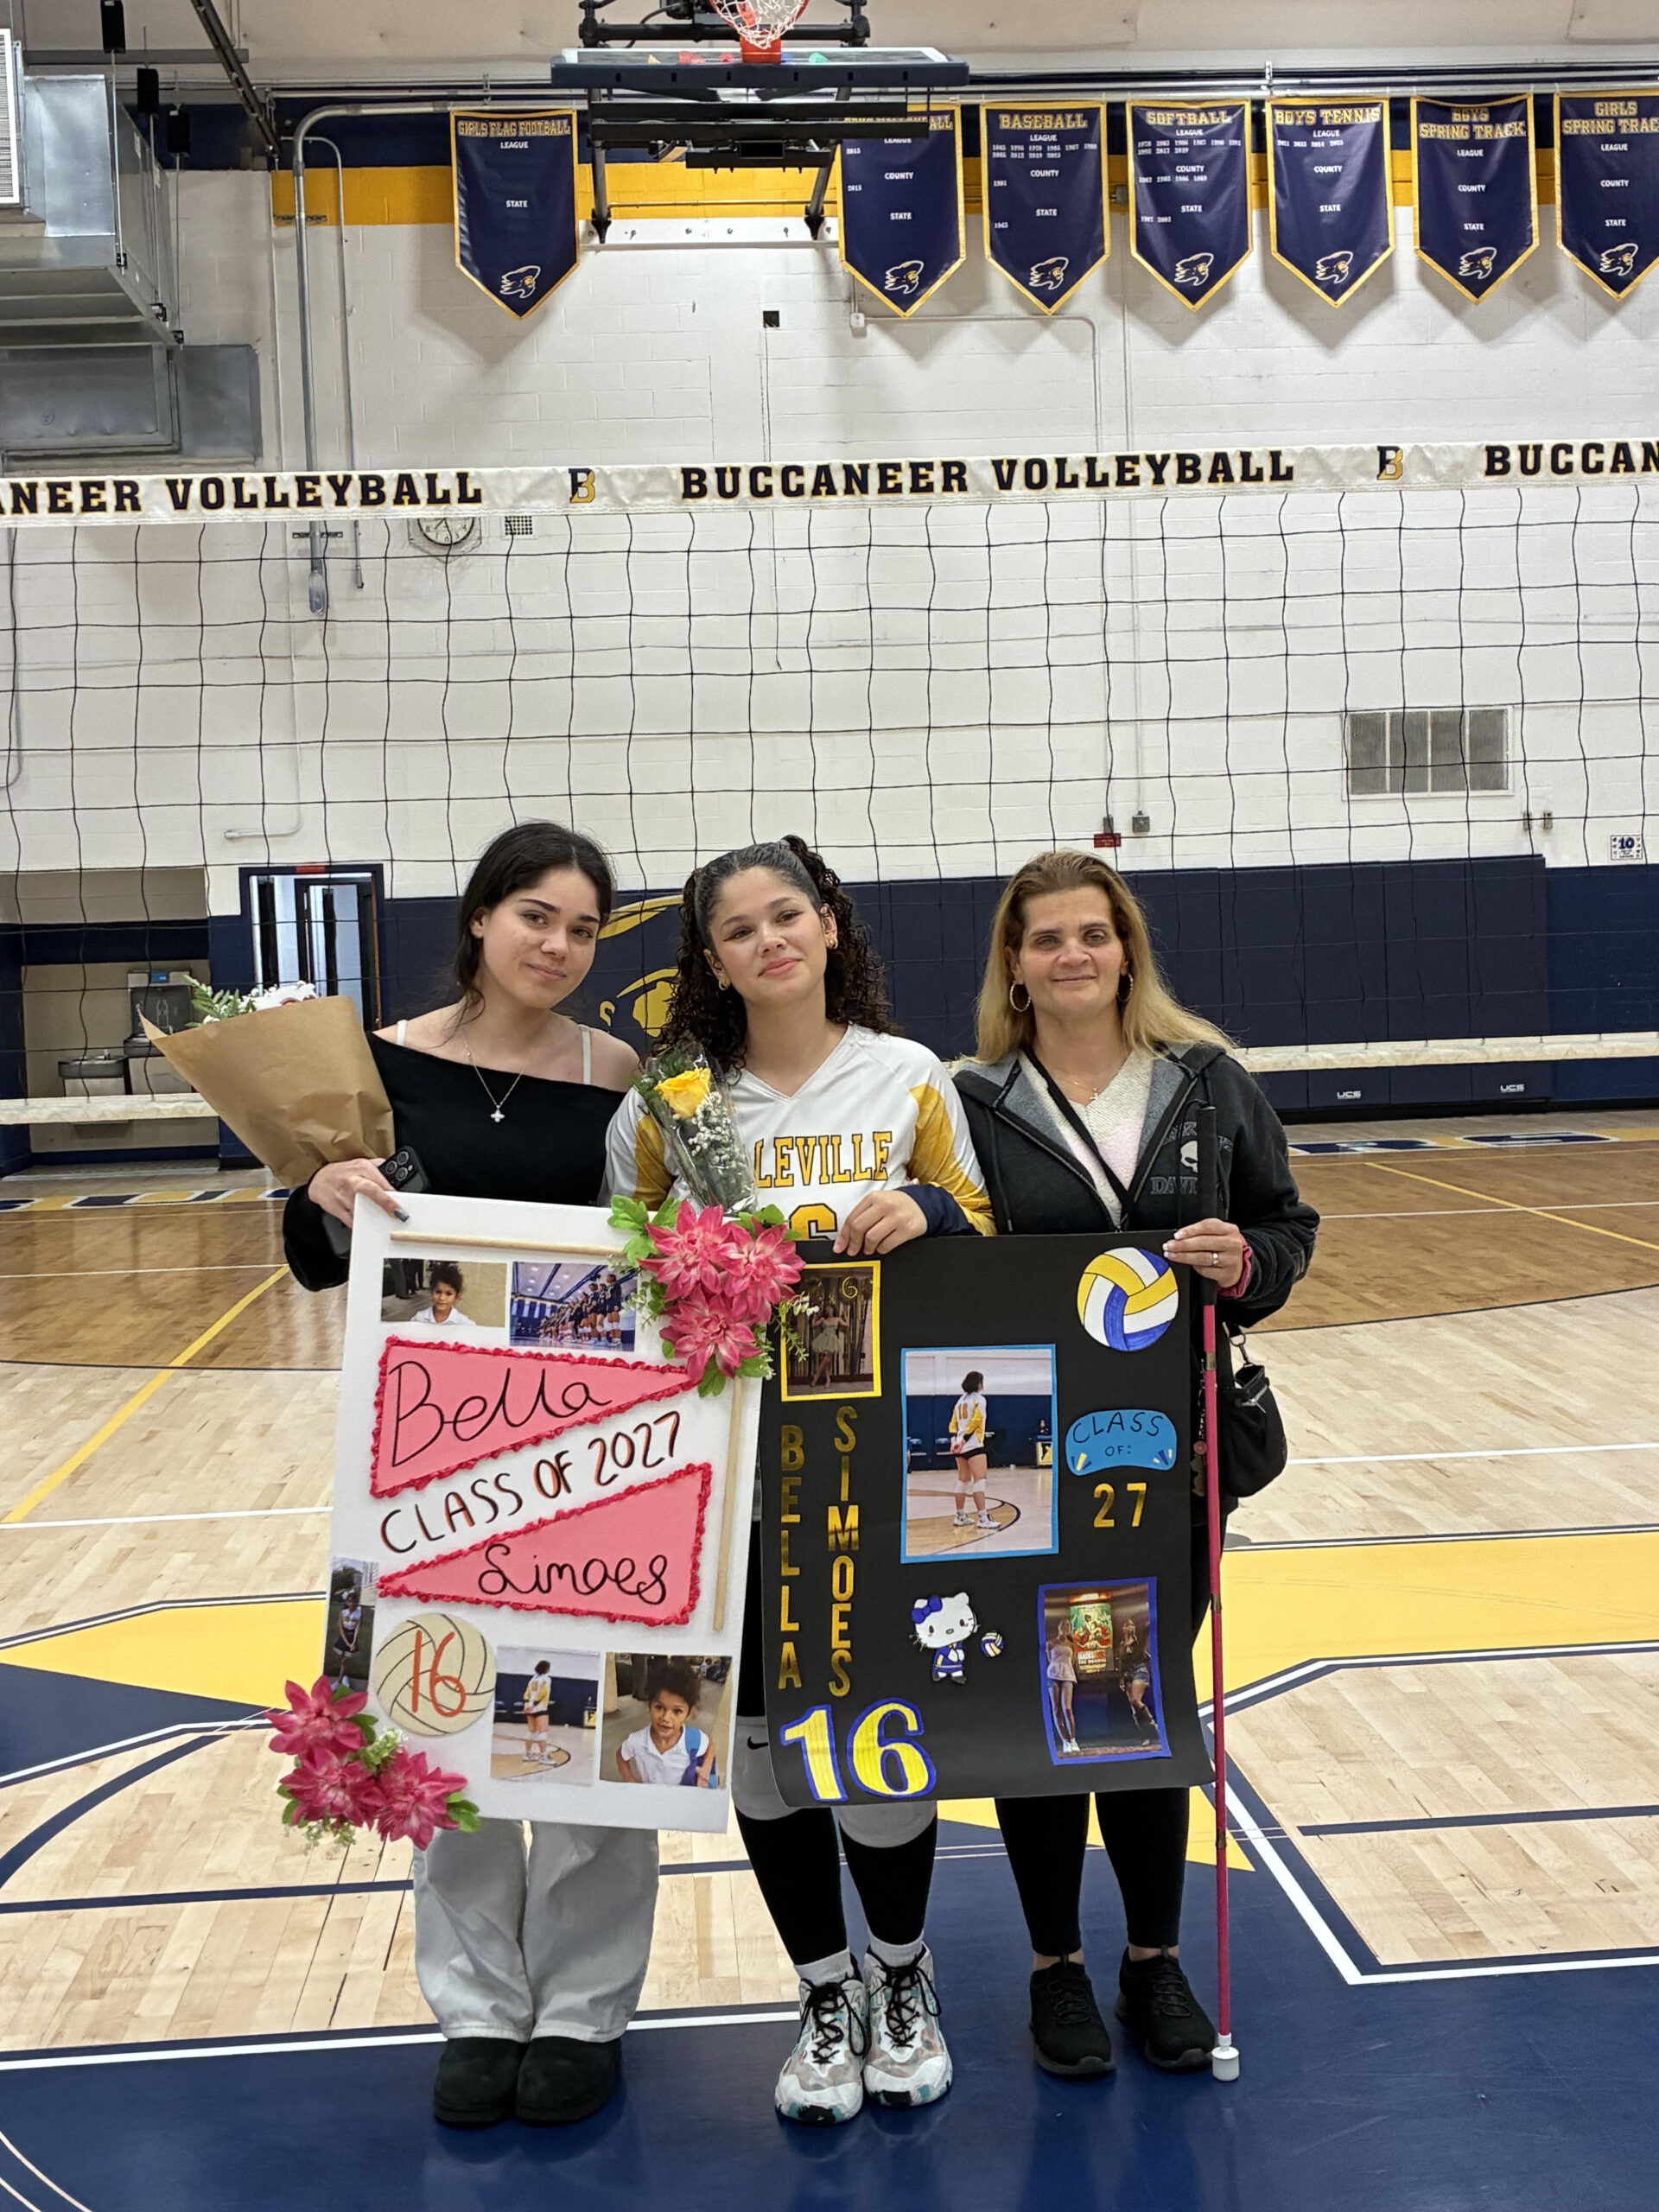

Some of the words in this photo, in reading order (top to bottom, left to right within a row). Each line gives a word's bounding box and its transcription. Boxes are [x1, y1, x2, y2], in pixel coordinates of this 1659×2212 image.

[1146, 111, 1232, 125] SOFTBALL
[1274, 109, 1317, 124] BOYS
[1320, 107, 1381, 124] TENNIS
[1452, 108, 1490, 122] BOYS
[1594, 101, 1637, 117] GIRLS
[457, 120, 488, 137] GIRLS
[489, 121, 517, 137] FLAG
[518, 119, 571, 137] FOOTBALL
[999, 112, 1089, 130] BASEBALL
[1562, 119, 1615, 135] SPRING
[1419, 123, 1470, 140] SPRING
[1472, 121, 1527, 139] TRACK
[1600, 143, 1628, 152] LEAGUE
[505, 200, 528, 208] STATE
[680, 460, 969, 500] BUCCANEER
[991, 448, 1294, 491] VOLLEYBALL
[0, 479, 143, 515] NEER
[166, 471, 483, 511] VOLLEYBALL
[1618, 836, 1635, 849] 10
[1500, 1084, 1524, 1092] UCS
[388, 1360, 613, 1468] Bella
[1072, 1411, 1166, 1445] CLASS
[1104, 1445, 1132, 1457] OF:
[379, 1473, 523, 1554] CLASS
[533, 1449, 573, 1499] OF
[588, 1410, 681, 1487] 2027
[1093, 1482, 1147, 1528] 27
[779, 1425, 804, 1689] BELLA
[828, 1405, 859, 1698] SIMOES
[411, 1630, 467, 1718] 16
[779, 1696, 938, 1802] 16
